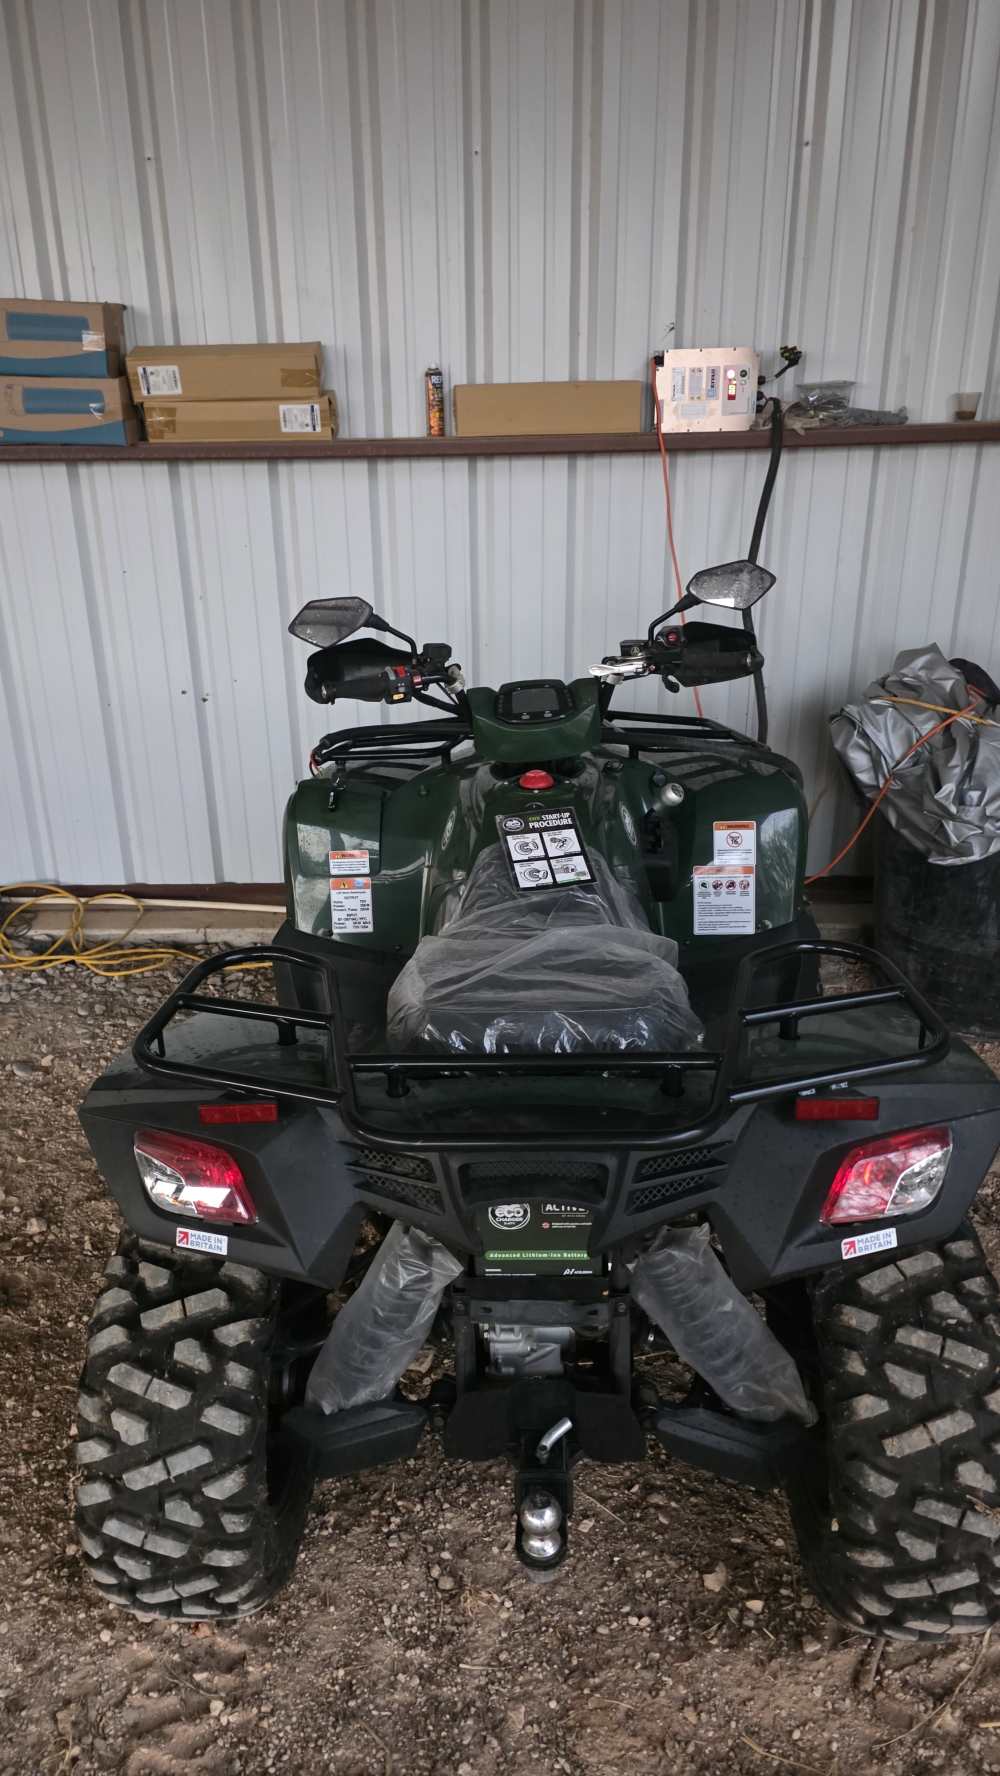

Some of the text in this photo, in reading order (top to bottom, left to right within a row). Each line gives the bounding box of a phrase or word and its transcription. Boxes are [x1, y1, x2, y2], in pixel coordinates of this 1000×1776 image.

[542, 812, 570, 820] START-UP
[528, 818, 572, 828] PROCEDURE
[494, 1204, 524, 1218] eco
[190, 1232, 222, 1244] MADE IN
[857, 1234, 880, 1244] MADE
[190, 1241, 222, 1252] BRITAIN
[858, 1240, 892, 1252] BRITAIN
